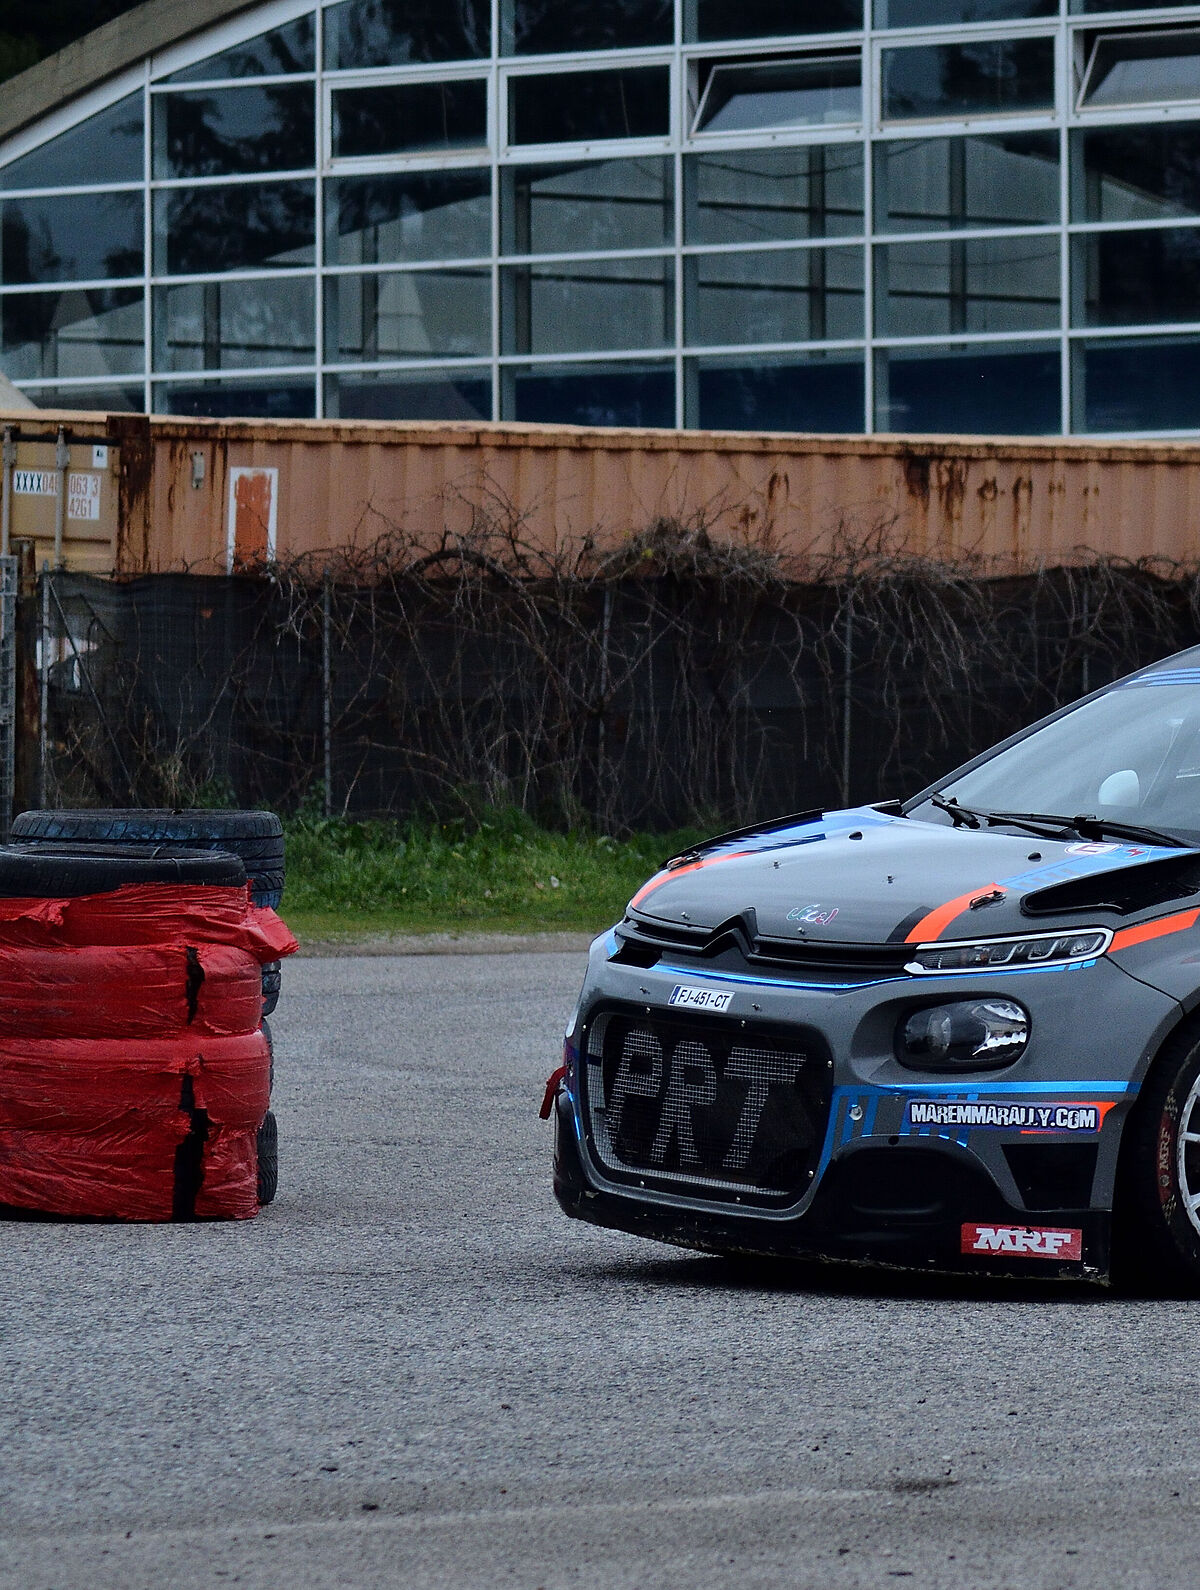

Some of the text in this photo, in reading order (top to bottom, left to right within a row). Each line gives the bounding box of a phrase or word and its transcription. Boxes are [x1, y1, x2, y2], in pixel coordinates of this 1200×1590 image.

[677, 989, 730, 1009] FJ-451-CT
[603, 1028, 808, 1169] PRT
[910, 1104, 1096, 1129] MAREMMARALLY.COM
[1158, 1127, 1170, 1171] MRF
[973, 1227, 1072, 1254] MRF
